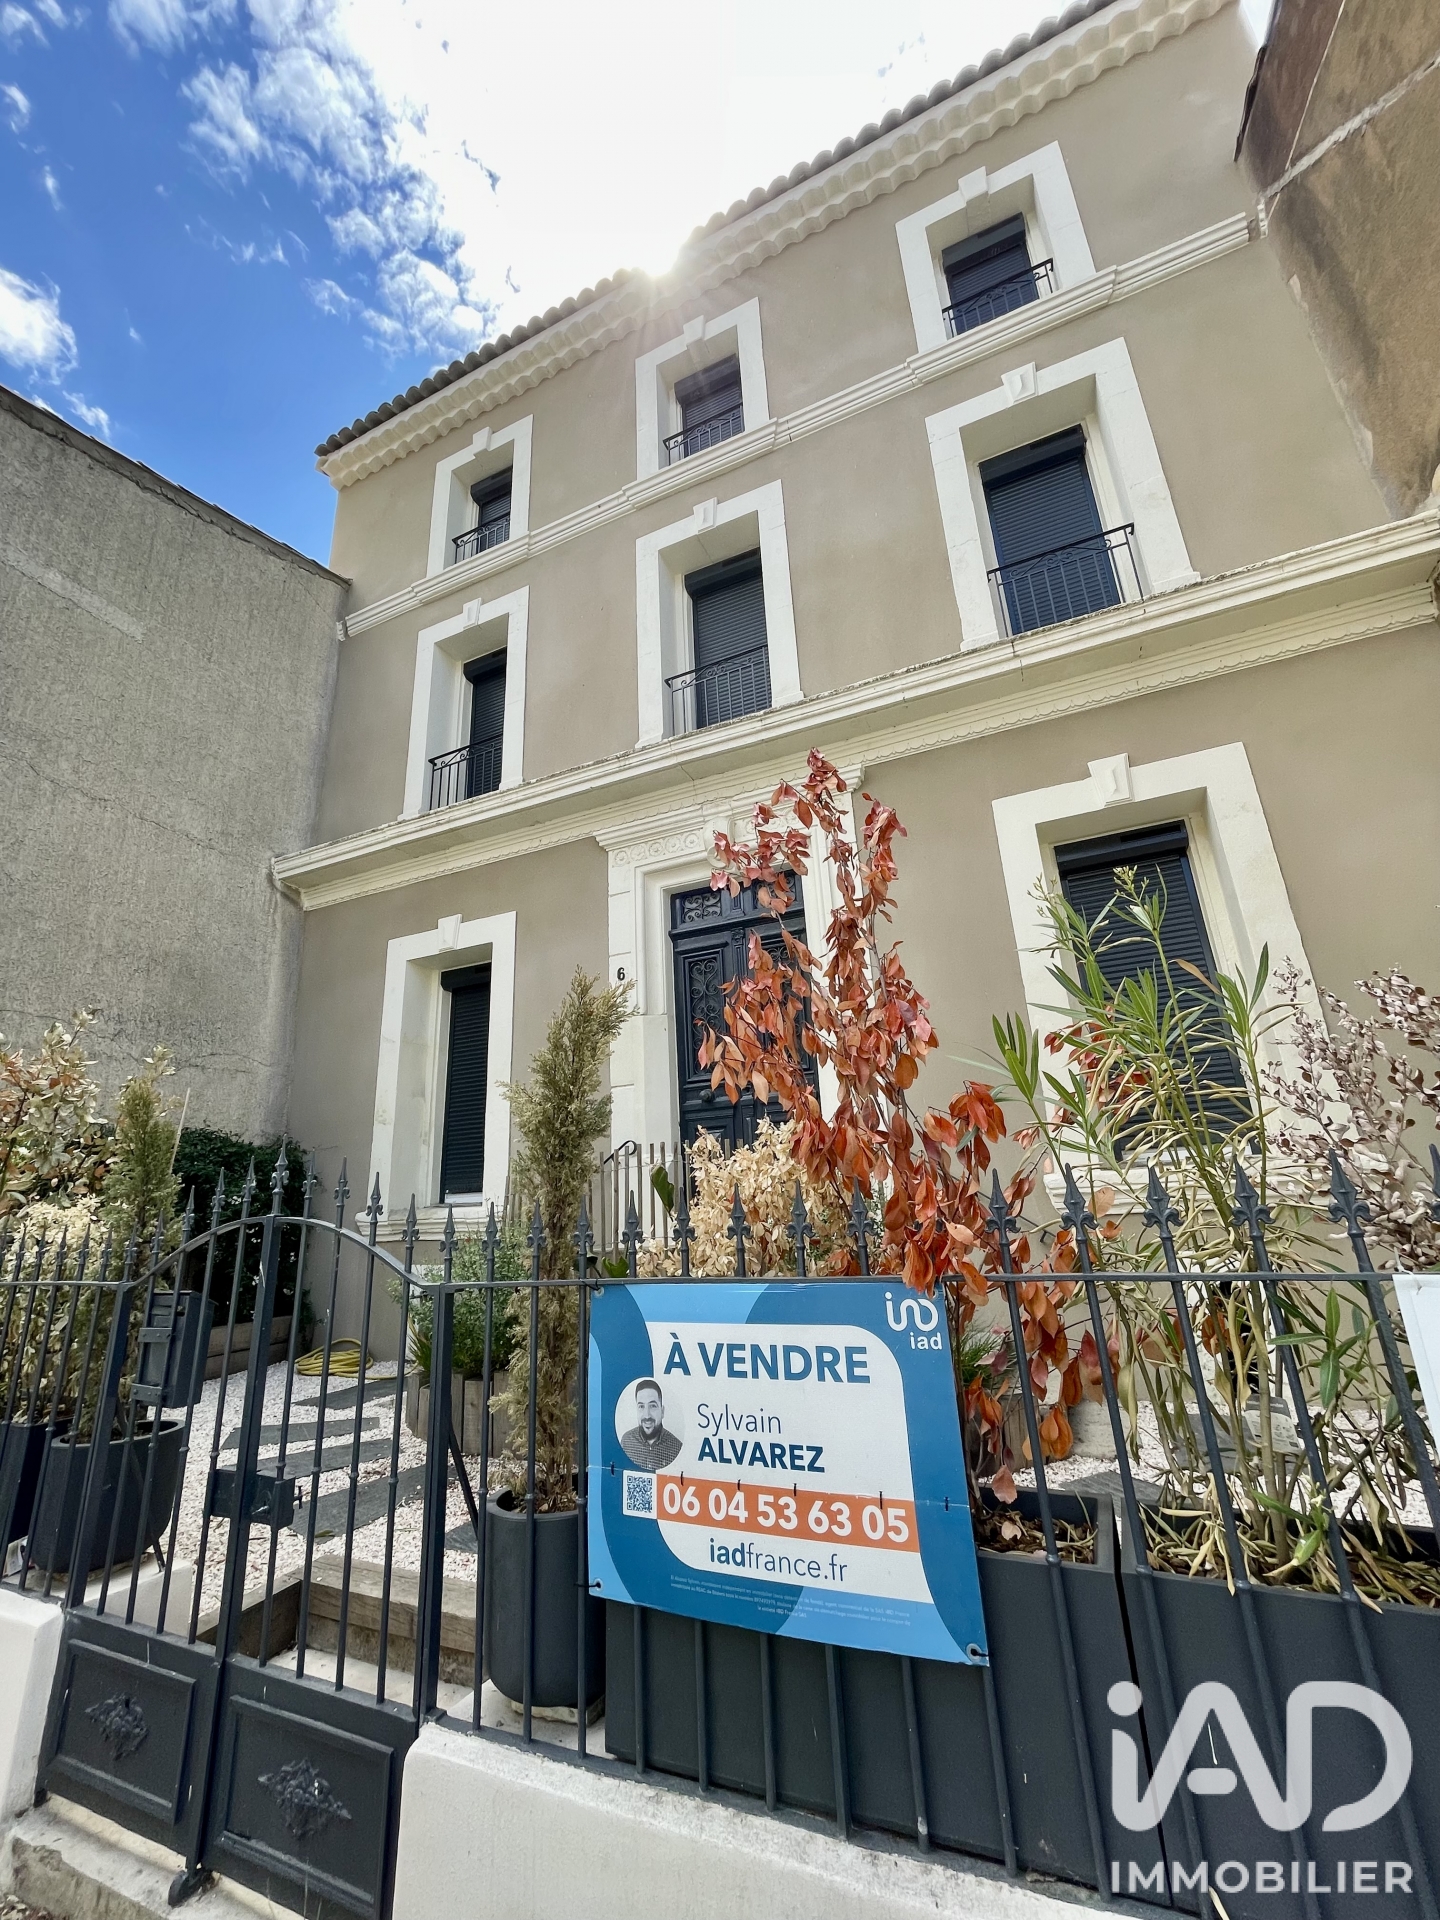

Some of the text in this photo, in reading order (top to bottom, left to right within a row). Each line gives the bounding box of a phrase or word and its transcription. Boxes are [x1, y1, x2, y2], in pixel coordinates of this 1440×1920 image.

[617, 967, 626, 981] 6
[663, 1332, 871, 1384] À VENDRE
[910, 1332, 942, 1350] iad
[697, 1402, 782, 1437] Sylvain
[697, 1439, 825, 1473] ALVAREZ
[663, 1482, 909, 1543] 06 04 53 63 05
[709, 1538, 848, 1582] iadfrance.fr
